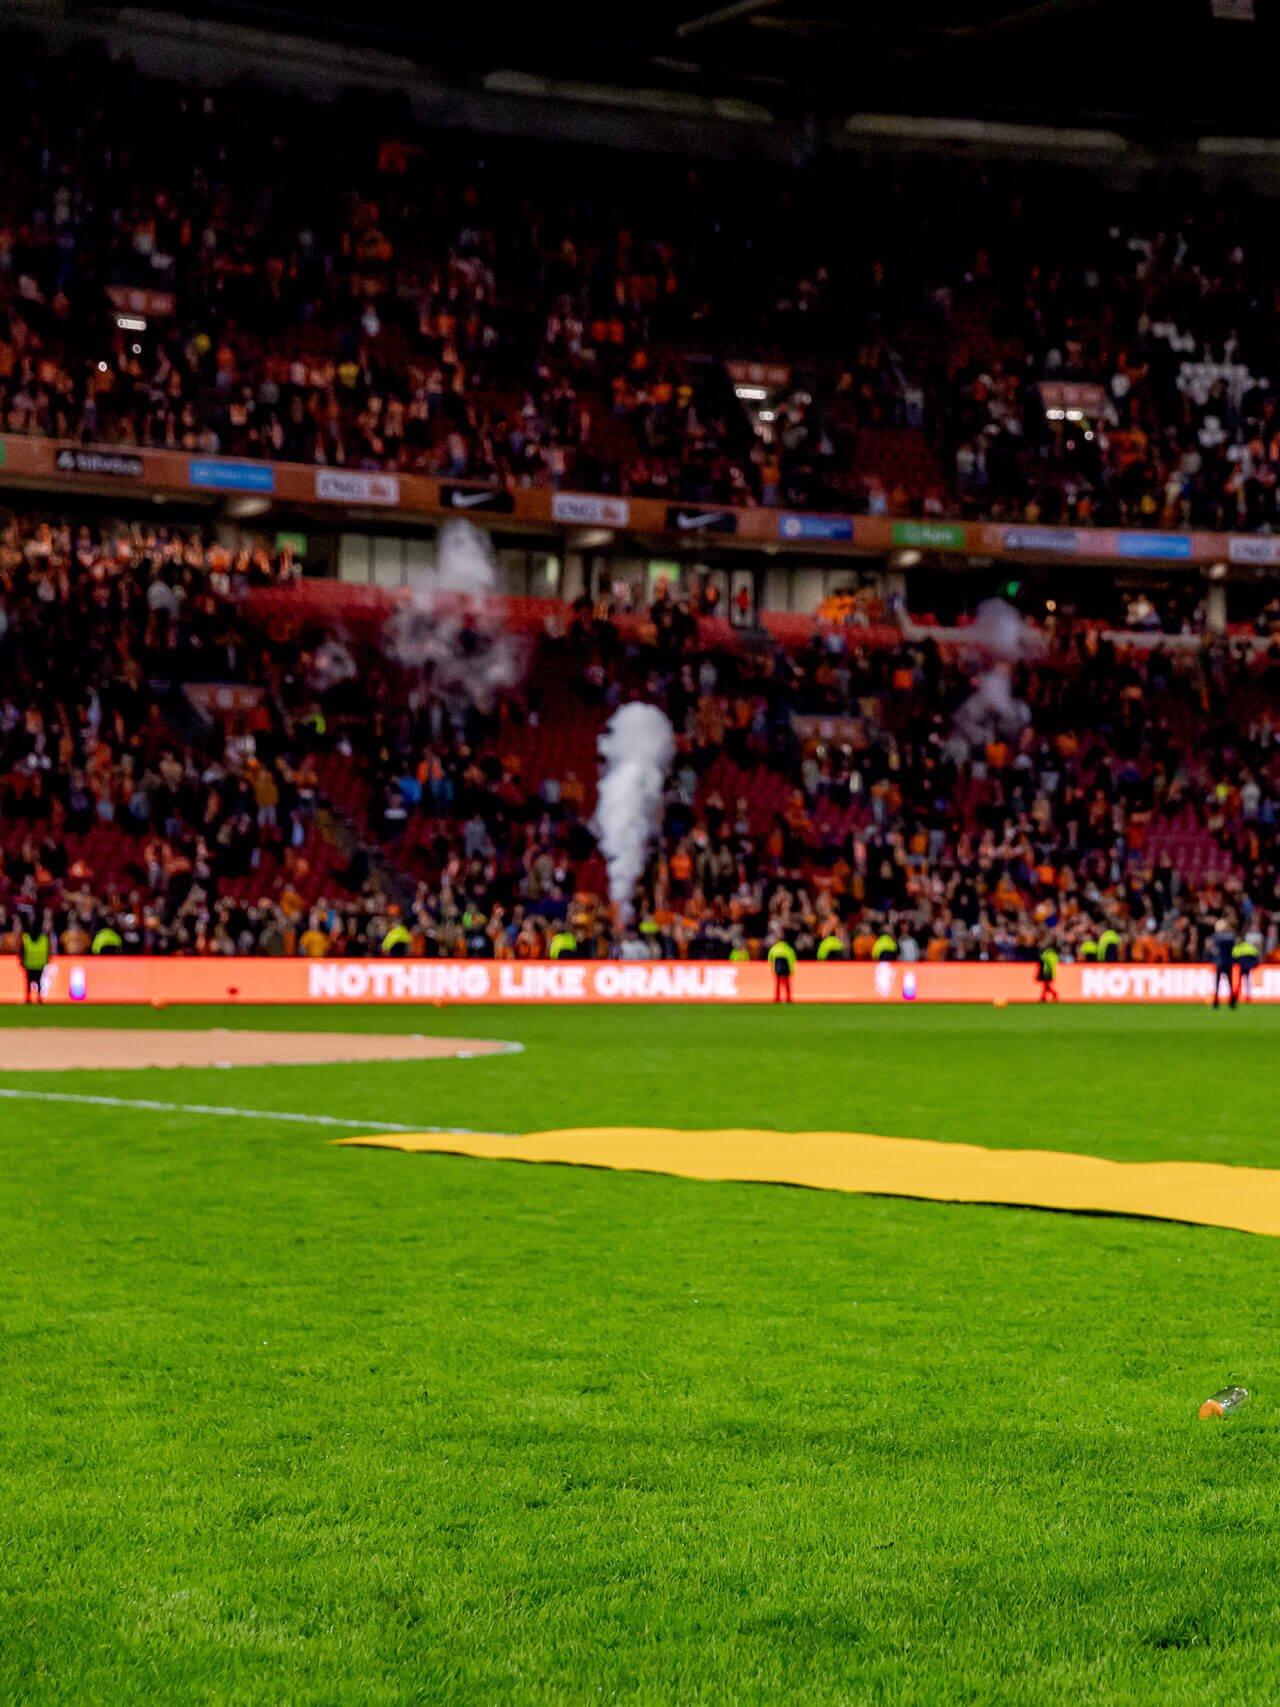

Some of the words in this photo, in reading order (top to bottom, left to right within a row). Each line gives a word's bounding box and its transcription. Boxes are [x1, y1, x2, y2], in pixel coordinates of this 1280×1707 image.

[308, 965, 490, 996] NOTHING
[500, 966, 586, 997] LIKE
[594, 966, 739, 997] ORANJE
